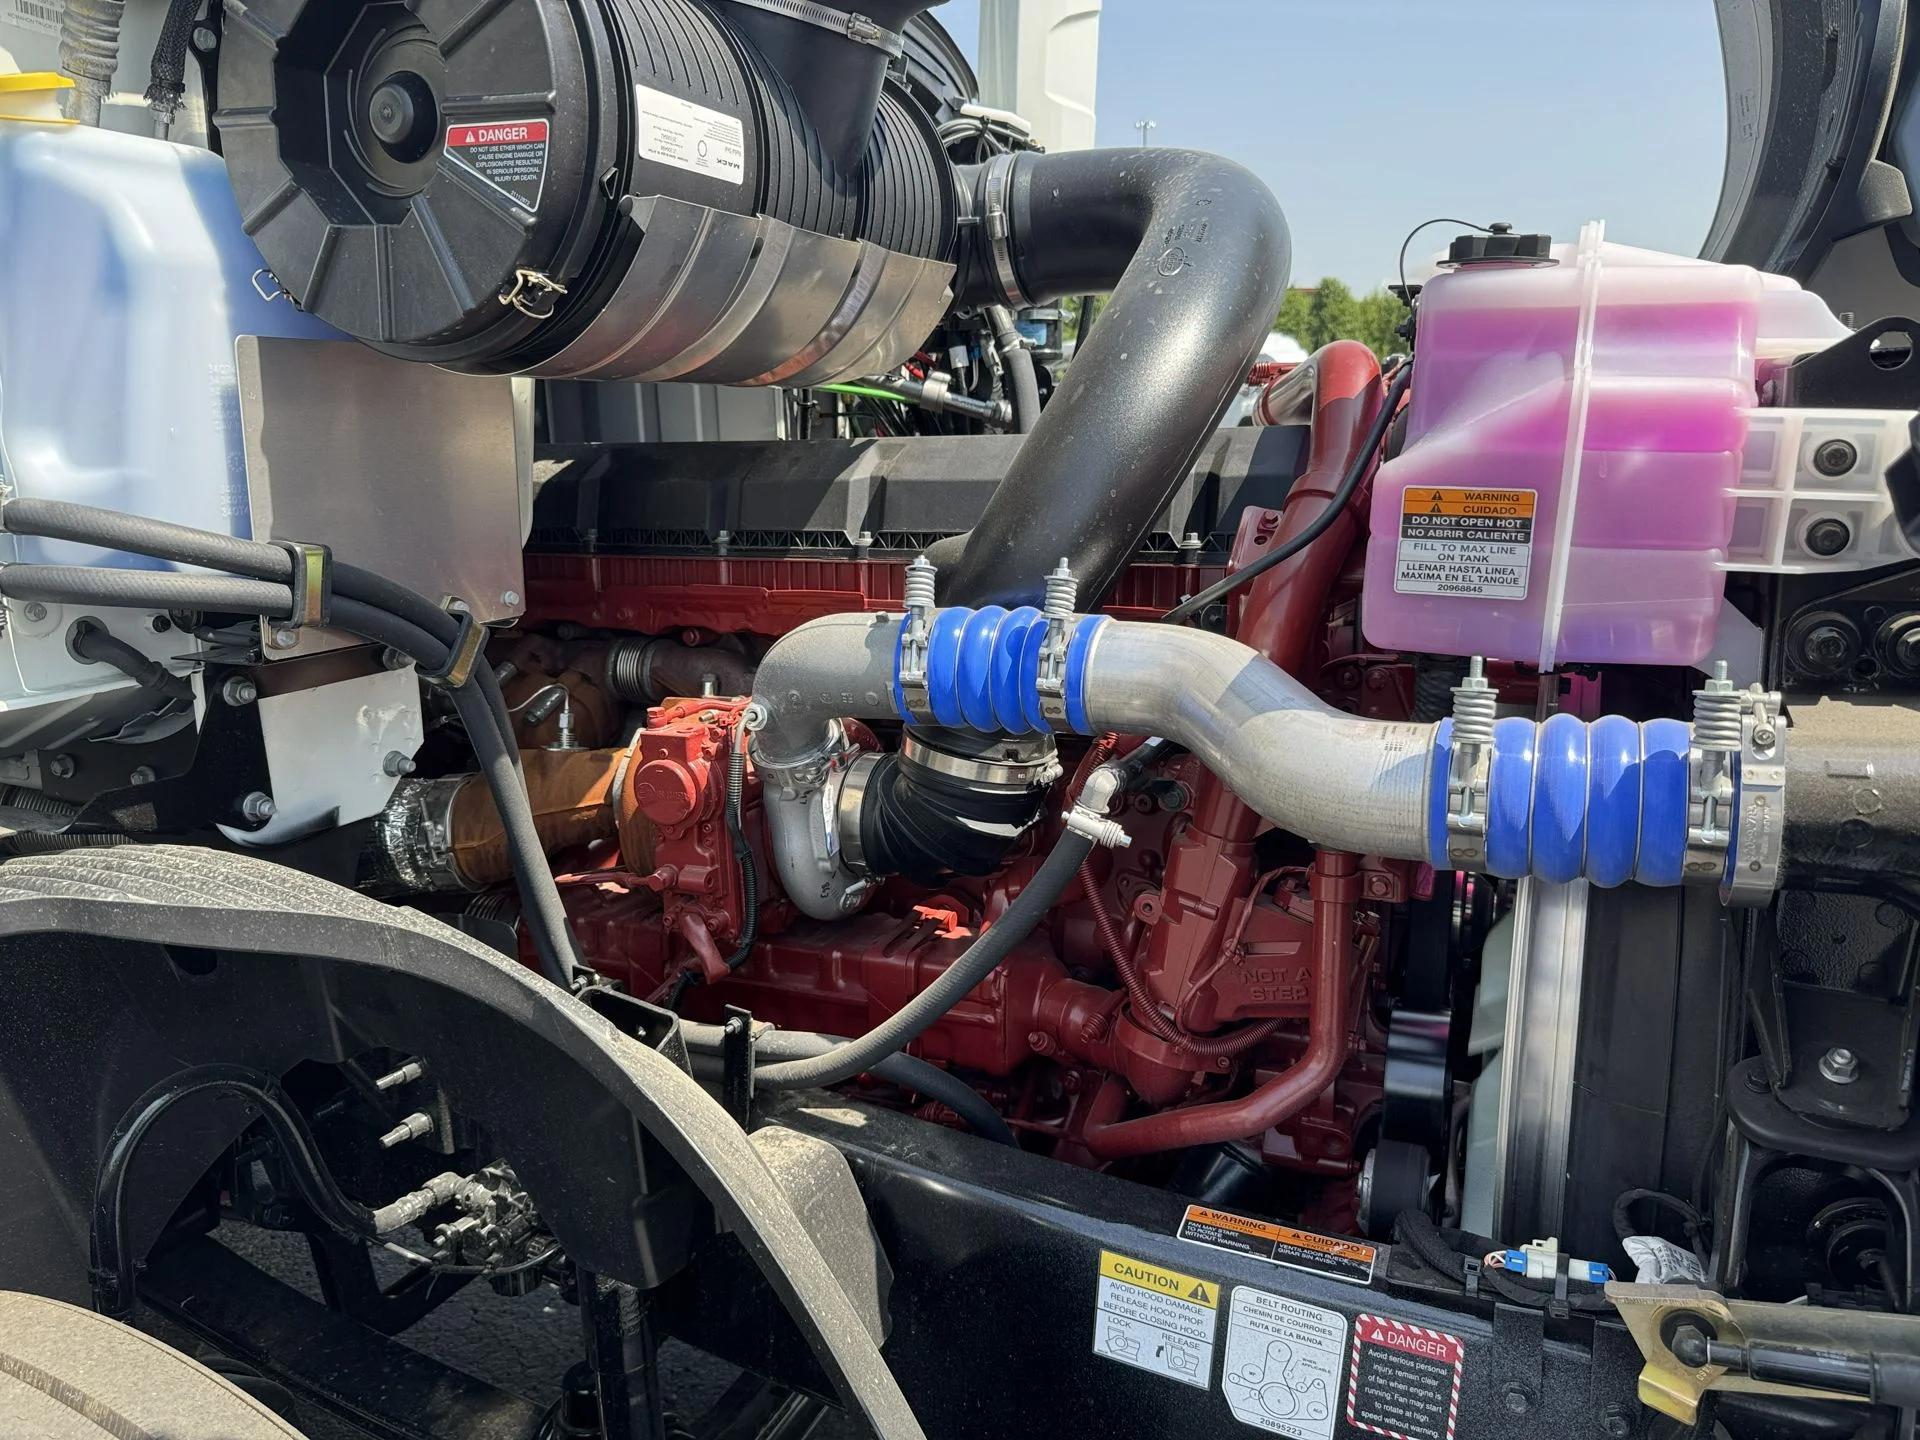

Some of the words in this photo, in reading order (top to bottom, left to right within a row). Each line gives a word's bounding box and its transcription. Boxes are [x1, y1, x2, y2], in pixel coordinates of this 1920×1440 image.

[479, 127, 528, 142] DANGER
[717, 158, 739, 169] MACK
[1465, 493, 1519, 501] WARNING
[1463, 506, 1516, 514] CUIDADO
[1433, 517, 1458, 525] NOT
[1461, 518, 1494, 526] OPEN
[1497, 520, 1522, 528] HOT
[1427, 530, 1463, 538] ABRIR
[1467, 531, 1525, 541] CALIENTE
[1414, 543, 1438, 551] FILL
[1442, 544, 1457, 552] TO
[1460, 544, 1486, 553] MAX
[1490, 546, 1516, 554] LINE
[1459, 554, 1489, 562] TANK
[1407, 564, 1445, 572] LLENAR
[1449, 565, 1481, 574] HASTA
[1486, 566, 1515, 575] LINEA
[1402, 572, 1442, 581] MAXIMA
[1445, 574, 1458, 582] EN
[1477, 576, 1519, 585] TANQUE
[1244, 968, 1288, 984] NOT
[1296, 967, 1311, 981] A
[1253, 986, 1308, 1000] STEP
[1212, 1213, 1266, 1230] WARNING
[1186, 1231, 1216, 1240] WITHOUT
[1198, 1228, 1222, 1237] ROTATE
[1218, 1228, 1239, 1237] START
[1278, 1248, 1300, 1256] GIRAR
[1304, 1235, 1359, 1252] CUIDADO
[1280, 1244, 1323, 1256] VENTILADOR
[1325, 1254, 1348, 1264] PUEDE
[1114, 1263, 1178, 1290] CAUTION
[1110, 1282, 1135, 1294] AVOID
[1138, 1290, 1163, 1303] HOOD
[1111, 1293, 1147, 1310] RELEASE
[1150, 1305, 1176, 1318] HOOD
[1179, 1315, 1203, 1325] PROP
[1256, 1297, 1278, 1308] BELT
[1281, 1304, 1322, 1321] ROUTING
[1104, 1301, 1138, 1316] BEFORE
[1139, 1312, 1177, 1329] CLOSING
[1180, 1326, 1207, 1339] HOOD.
[1108, 1316, 1131, 1328] LOCK
[1243, 1305, 1272, 1319] CHEMIN
[1275, 1314, 1284, 1322] DE
[1287, 1319, 1332, 1336] COURROIES
[1162, 1333, 1200, 1350] RELEASE
[1250, 1321, 1269, 1331] RUTA
[1284, 1330, 1293, 1338] LA
[1296, 1334, 1322, 1346] BANDA
[1388, 1332, 1446, 1357] DANGER
[1368, 1349, 1387, 1360] Avoid
[1389, 1356, 1414, 1366] serious
[1416, 1362, 1447, 1375] personal
[1396, 1370, 1419, 1380] remain
[1421, 1377, 1438, 1386] clear
[1377, 1377, 1387, 1385] fan
[1390, 1381, 1408, 1391] when
[1410, 1386, 1433, 1397] engine
[1365, 1387, 1392, 1400] running.
[1395, 1394, 1407, 1403] Fan
[1410, 1399, 1424, 1409] may
[1426, 1404, 1442, 1413] start
[1384, 1404, 1403, 1414] rotate
[1414, 1413, 1428, 1422] high
[1260, 1418, 1302, 1436] 20895223
[1361, 1411, 1382, 1421] speed
[1384, 1417, 1408, 1429] without
[1410, 1425, 1439, 1438] warning.
